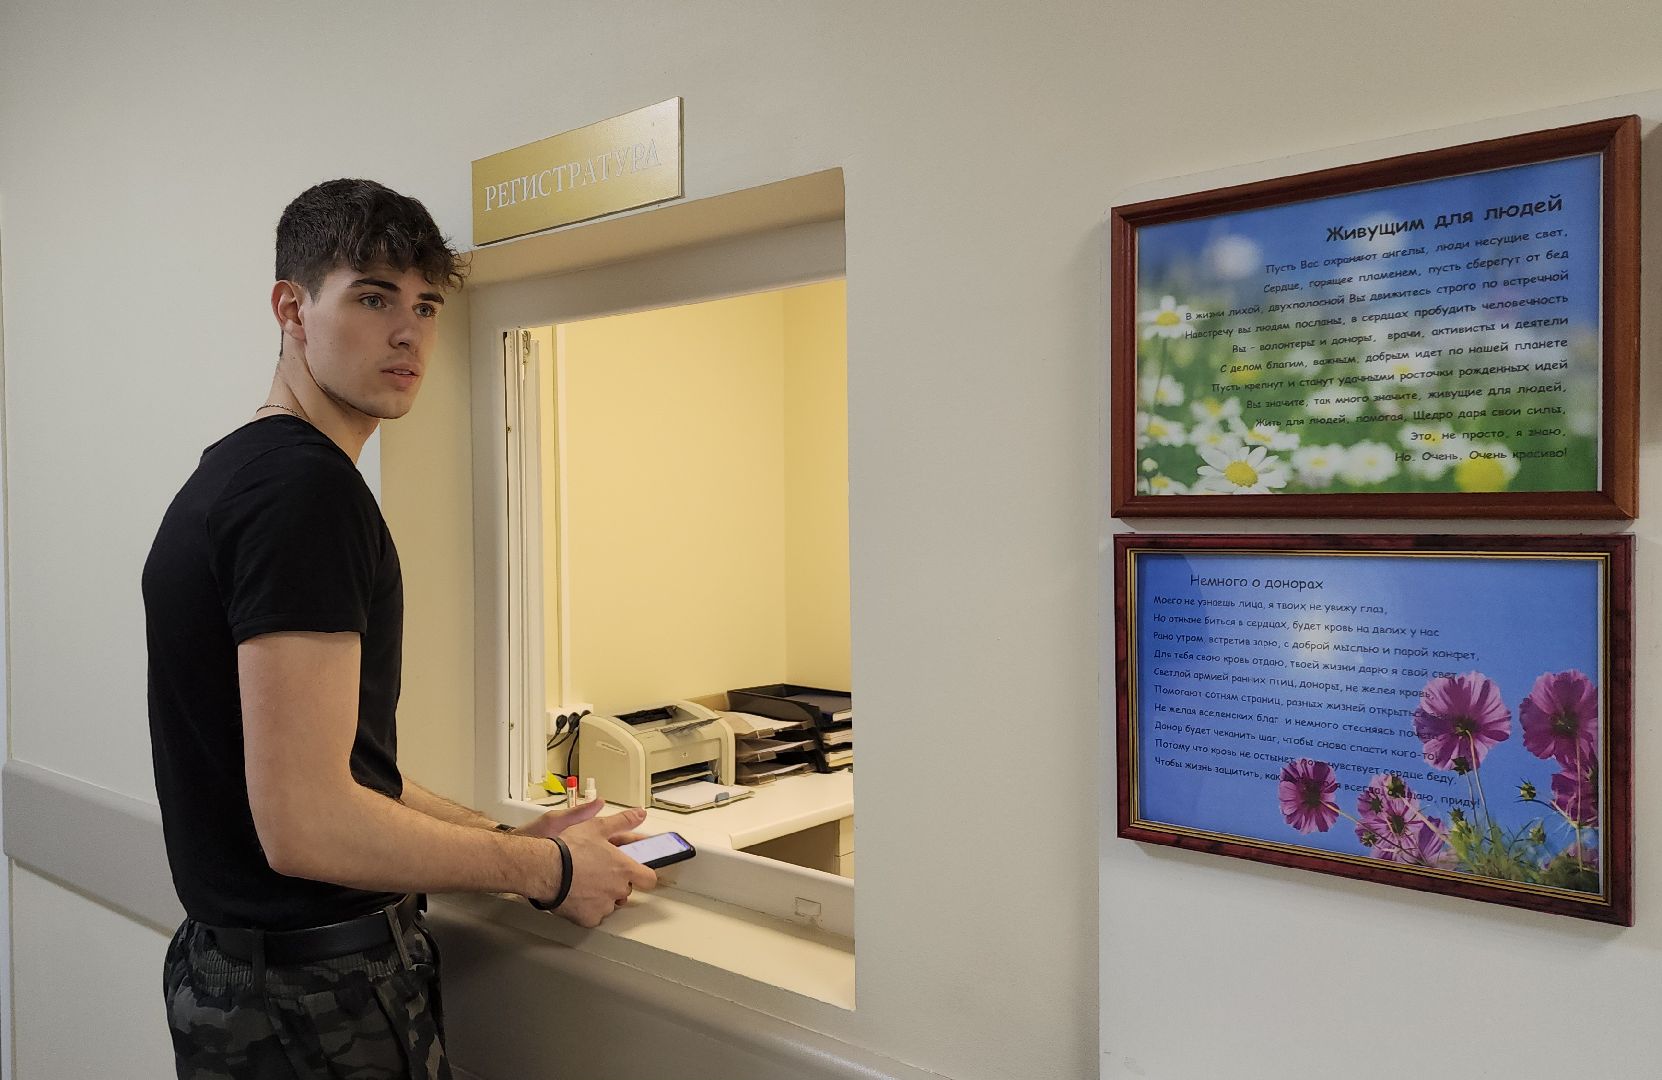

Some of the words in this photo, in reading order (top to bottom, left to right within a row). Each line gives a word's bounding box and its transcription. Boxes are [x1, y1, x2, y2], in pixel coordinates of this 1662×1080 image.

[484, 138, 662, 212] РЕГИСТРАТУРА
[1326, 218, 1424, 242] Живущим
[1434, 211, 1472, 229] для
[1484, 193, 1562, 220] людей
[1265, 264, 1296, 275] Пусть
[1300, 259, 1319, 269] Вас
[1323, 253, 1377, 267] охраняют
[1435, 241, 1469, 252] люди
[1474, 233, 1529, 246] несущие
[1309, 276, 1353, 288] горящее
[1428, 264, 1461, 275] пусть
[1466, 256, 1520, 269] сберегут
[1525, 253, 1540, 262] от
[1545, 249, 1568, 259] бед
[1268, 294, 1344, 312] двухполосной
[1349, 293, 1366, 303] Вы
[1369, 288, 1431, 301] движитесь
[1436, 282, 1476, 295] строго
[1482, 280, 1498, 288] по
[1503, 269, 1568, 287] встречной
[1185, 328, 1233, 339] Навстречу
[1237, 326, 1251, 334] вы
[1254, 323, 1290, 332] людям
[1361, 310, 1408, 323] сердцах
[1414, 304, 1476, 318] пробудить
[1481, 295, 1568, 309] человечность
[1232, 344, 1246, 353] Вы
[1259, 339, 1315, 351] волонтеры
[1431, 323, 1495, 336] активисты
[1514, 317, 1568, 329] деятели
[1229, 363, 1262, 373] делом
[1364, 351, 1409, 363] добрым
[1415, 349, 1442, 358] идет
[1448, 347, 1463, 355] по
[1468, 341, 1508, 353] нашей
[1514, 339, 1567, 350] планете
[1212, 383, 1240, 393] Пусть
[1244, 381, 1283, 391] крепнут
[1299, 377, 1334, 387] станут
[1399, 370, 1453, 382] росточки
[1458, 363, 1529, 378] рожденных
[1534, 359, 1567, 371] идей
[1246, 400, 1261, 408] Вы
[1334, 395, 1369, 403] много
[1427, 388, 1482, 399] живущие
[1487, 387, 1511, 396] для
[1255, 418, 1281, 427] Жить
[1412, 410, 1453, 422] Щедро
[1457, 410, 1486, 420] даря
[1491, 408, 1521, 416] свои
[1468, 450, 1507, 459] Очень
[1190, 574, 1247, 587] Немного
[1251, 578, 1260, 587] о
[1264, 579, 1323, 592] донорах
[1197, 599, 1235, 607] узнаешь
[1276, 602, 1306, 611] твоих
[1324, 604, 1357, 614] увижу
[1153, 613, 1166, 622] Но
[1204, 615, 1235, 625] биться
[1292, 620, 1321, 632] будет
[1324, 624, 1353, 633] кровь
[1356, 625, 1369, 633] на
[1153, 631, 1173, 640] Рано
[1208, 636, 1250, 646] встретив
[1291, 640, 1329, 652] доброй
[1332, 644, 1379, 653] мыслью
[1393, 647, 1428, 657] парой
[1153, 667, 1190, 678] Светлой
[1193, 672, 1228, 680] армией
[1345, 684, 1358, 692] не
[1173, 650, 1193, 660] тебя
[1223, 656, 1249, 665] кровь
[1289, 659, 1319, 669] твоей
[1358, 665, 1388, 676] дарю
[1401, 668, 1427, 677] свой
[1153, 684, 1201, 697] Помогают
[1204, 691, 1238, 701] сотням
[1286, 699, 1323, 708] разных
[1326, 703, 1365, 712] жизней
[1154, 703, 1166, 711] Не
[1169, 707, 1196, 715] желая
[1199, 709, 1253, 720] вселенских
[1294, 719, 1339, 729] немного
[1342, 724, 1395, 735] стесняясь
[1154, 720, 1182, 734] Донор
[1184, 724, 1211, 735] будет
[1213, 729, 1255, 739] чеканить
[1282, 736, 1313, 746] чтобы
[1349, 744, 1387, 755] спасти
[1154, 738, 1190, 752] Потому
[1210, 747, 1236, 756] кровь
[1327, 761, 1380, 776] чувствует
[1383, 768, 1423, 779] сердце
[1154, 756, 1182, 767] Чтобы
[1184, 762, 1212, 771] жизнь
[1265, 773, 1281, 782] как
